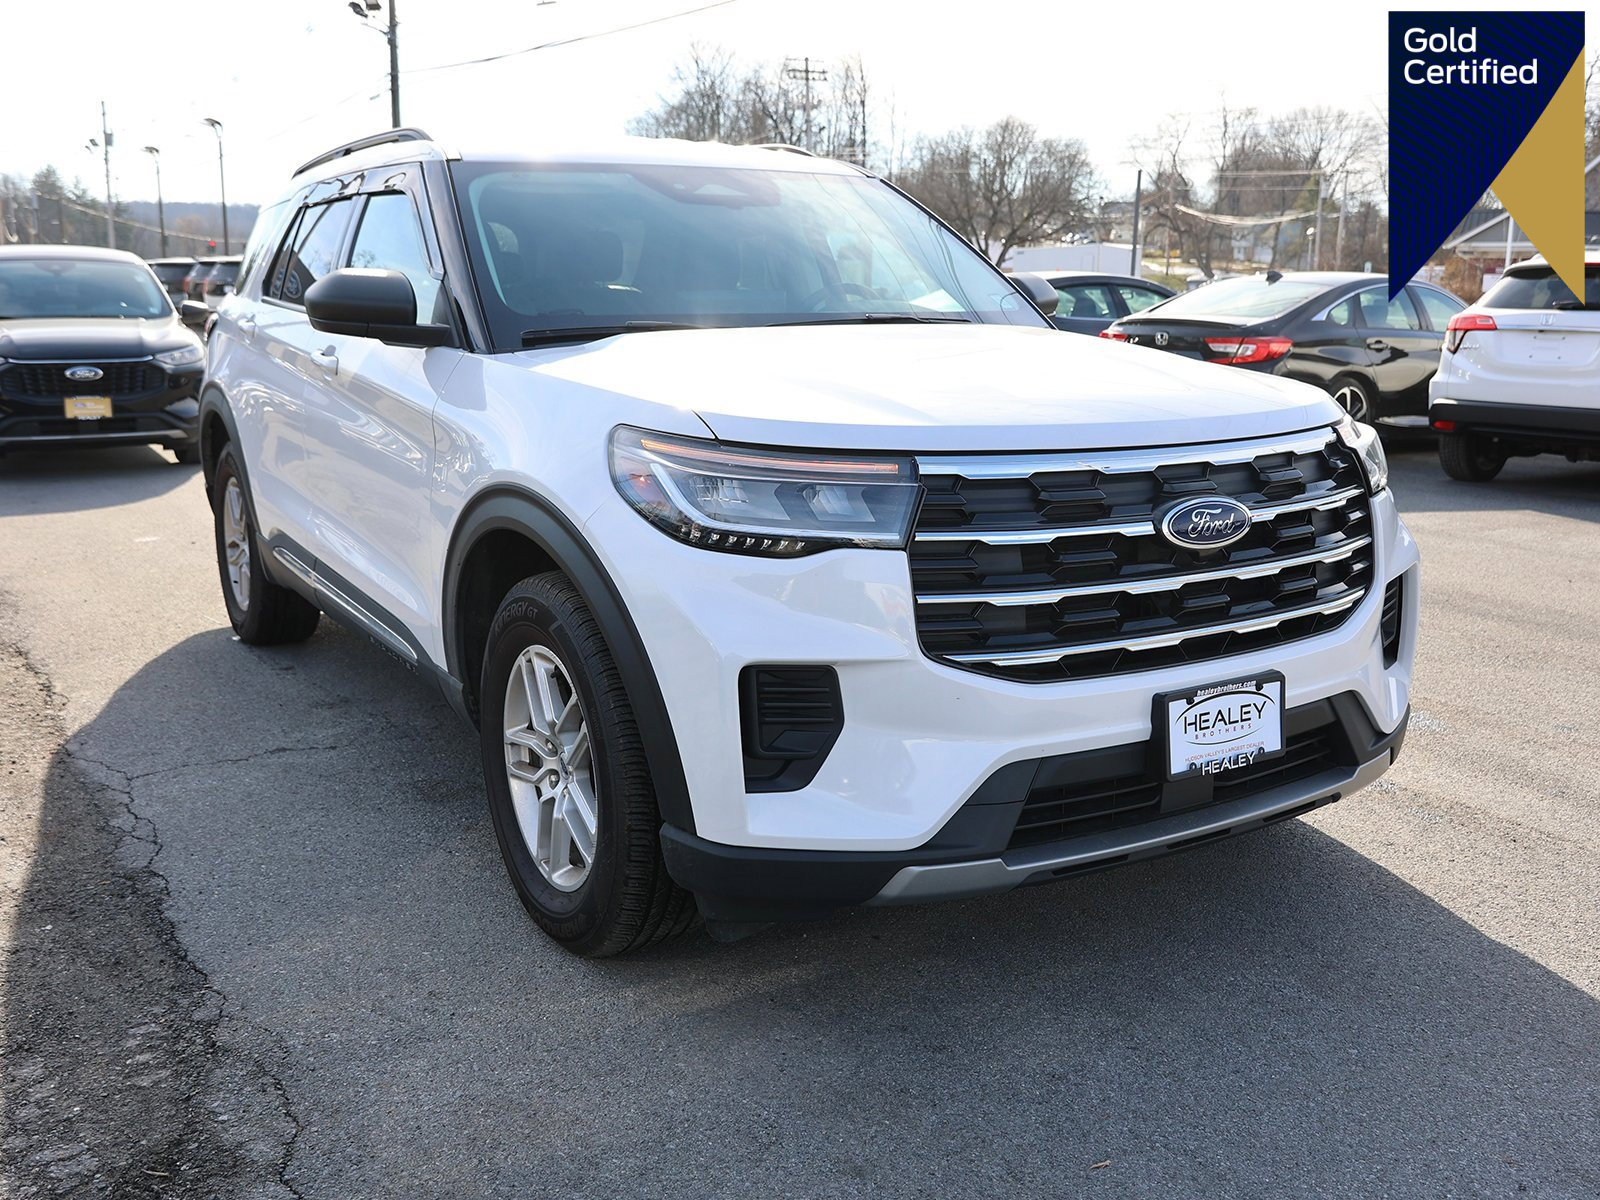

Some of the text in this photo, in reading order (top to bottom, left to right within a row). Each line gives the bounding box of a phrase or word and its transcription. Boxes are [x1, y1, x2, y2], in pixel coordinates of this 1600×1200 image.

[1187, 508, 1236, 538] Ford
[527, 606, 539, 620] GT
[1196, 680, 1257, 697] healeybrothers.com
[1183, 700, 1267, 735] HEALEY
[1195, 723, 1253, 740] BROTHERS
[1202, 751, 1256, 776] HEALEY
